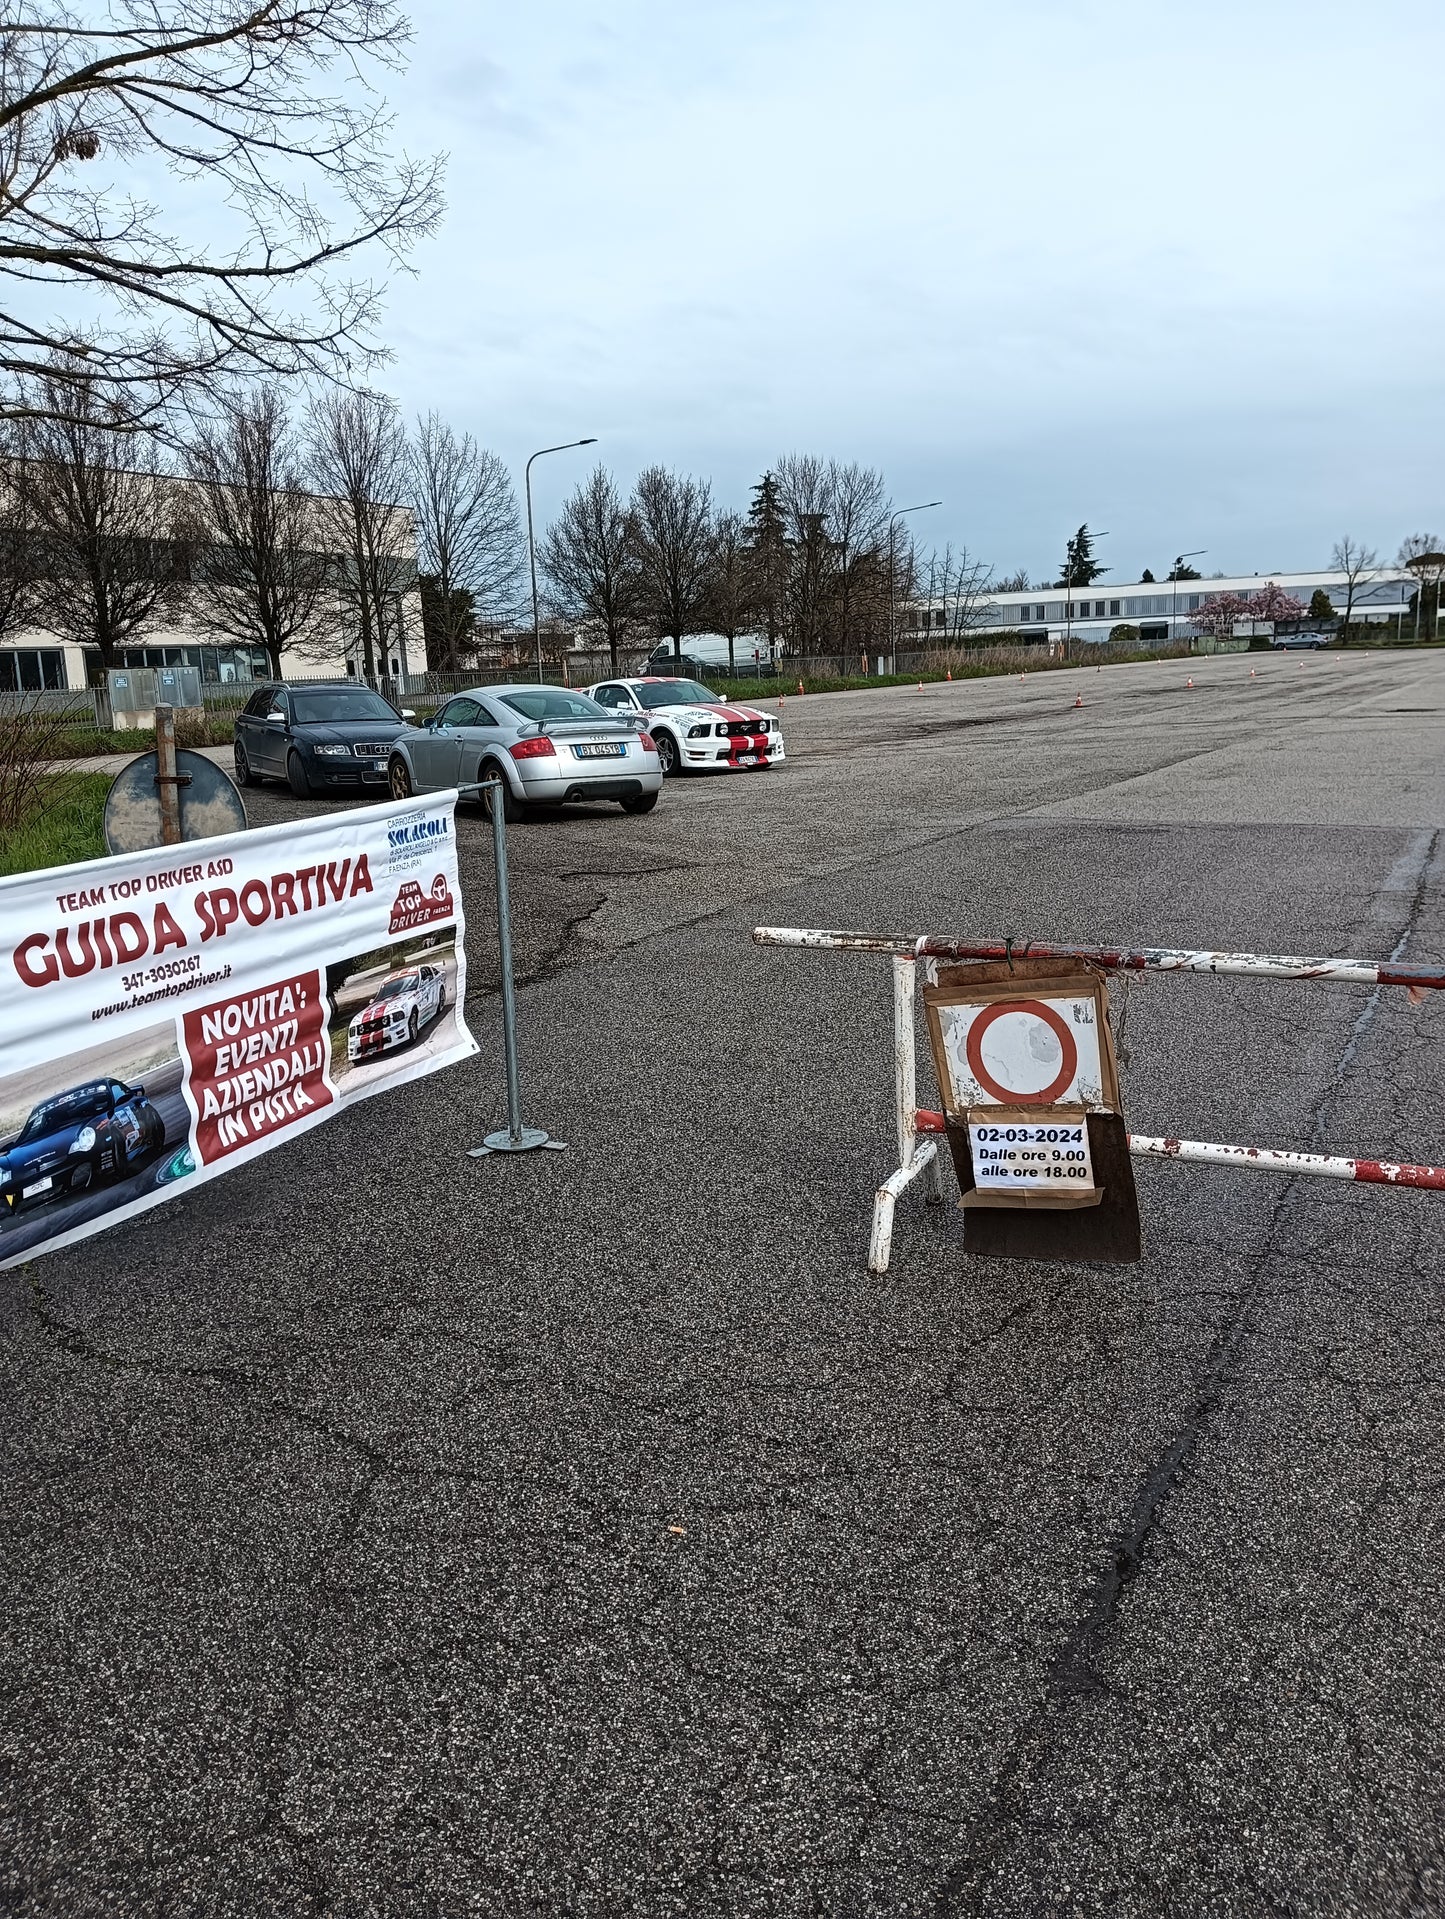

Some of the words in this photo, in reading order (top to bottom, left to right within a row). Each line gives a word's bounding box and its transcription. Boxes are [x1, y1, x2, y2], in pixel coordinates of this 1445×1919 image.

[387, 812, 426, 829] CARROZZERIA
[388, 817, 448, 848] SOLAROLI
[389, 862, 410, 873] FAENZA
[56, 887, 106, 913] TEAM
[108, 878, 142, 901] TOP
[146, 864, 205, 893] DRIVER
[207, 858, 234, 878] ASD
[401, 883, 418, 895] TEAM
[391, 908, 431, 930] DRIVER
[433, 905, 450, 915] FAENZA
[398, 894, 422, 912] TOP
[13, 901, 187, 988] GUIDA
[194, 853, 374, 942] SPORTIVA
[121, 955, 201, 992] 347-3030267
[92, 964, 232, 1021] www.teamtopdriver.it
[201, 983, 307, 1045] NOVITA':
[214, 1018, 298, 1077] EVENTI
[202, 1041, 322, 1121] AZIENDALI
[217, 1109, 249, 1147] IN
[249, 1081, 315, 1131] PISTA
[977, 1128, 1083, 1143] 02-03-2024
[979, 1149, 1017, 1160] Dalle
[1021, 1151, 1047, 1161] ore
[1052, 1149, 1086, 1161] 9.00
[981, 1165, 1009, 1176] alle
[1013, 1168, 1039, 1177] ore
[1044, 1166, 1087, 1178] 18.00
